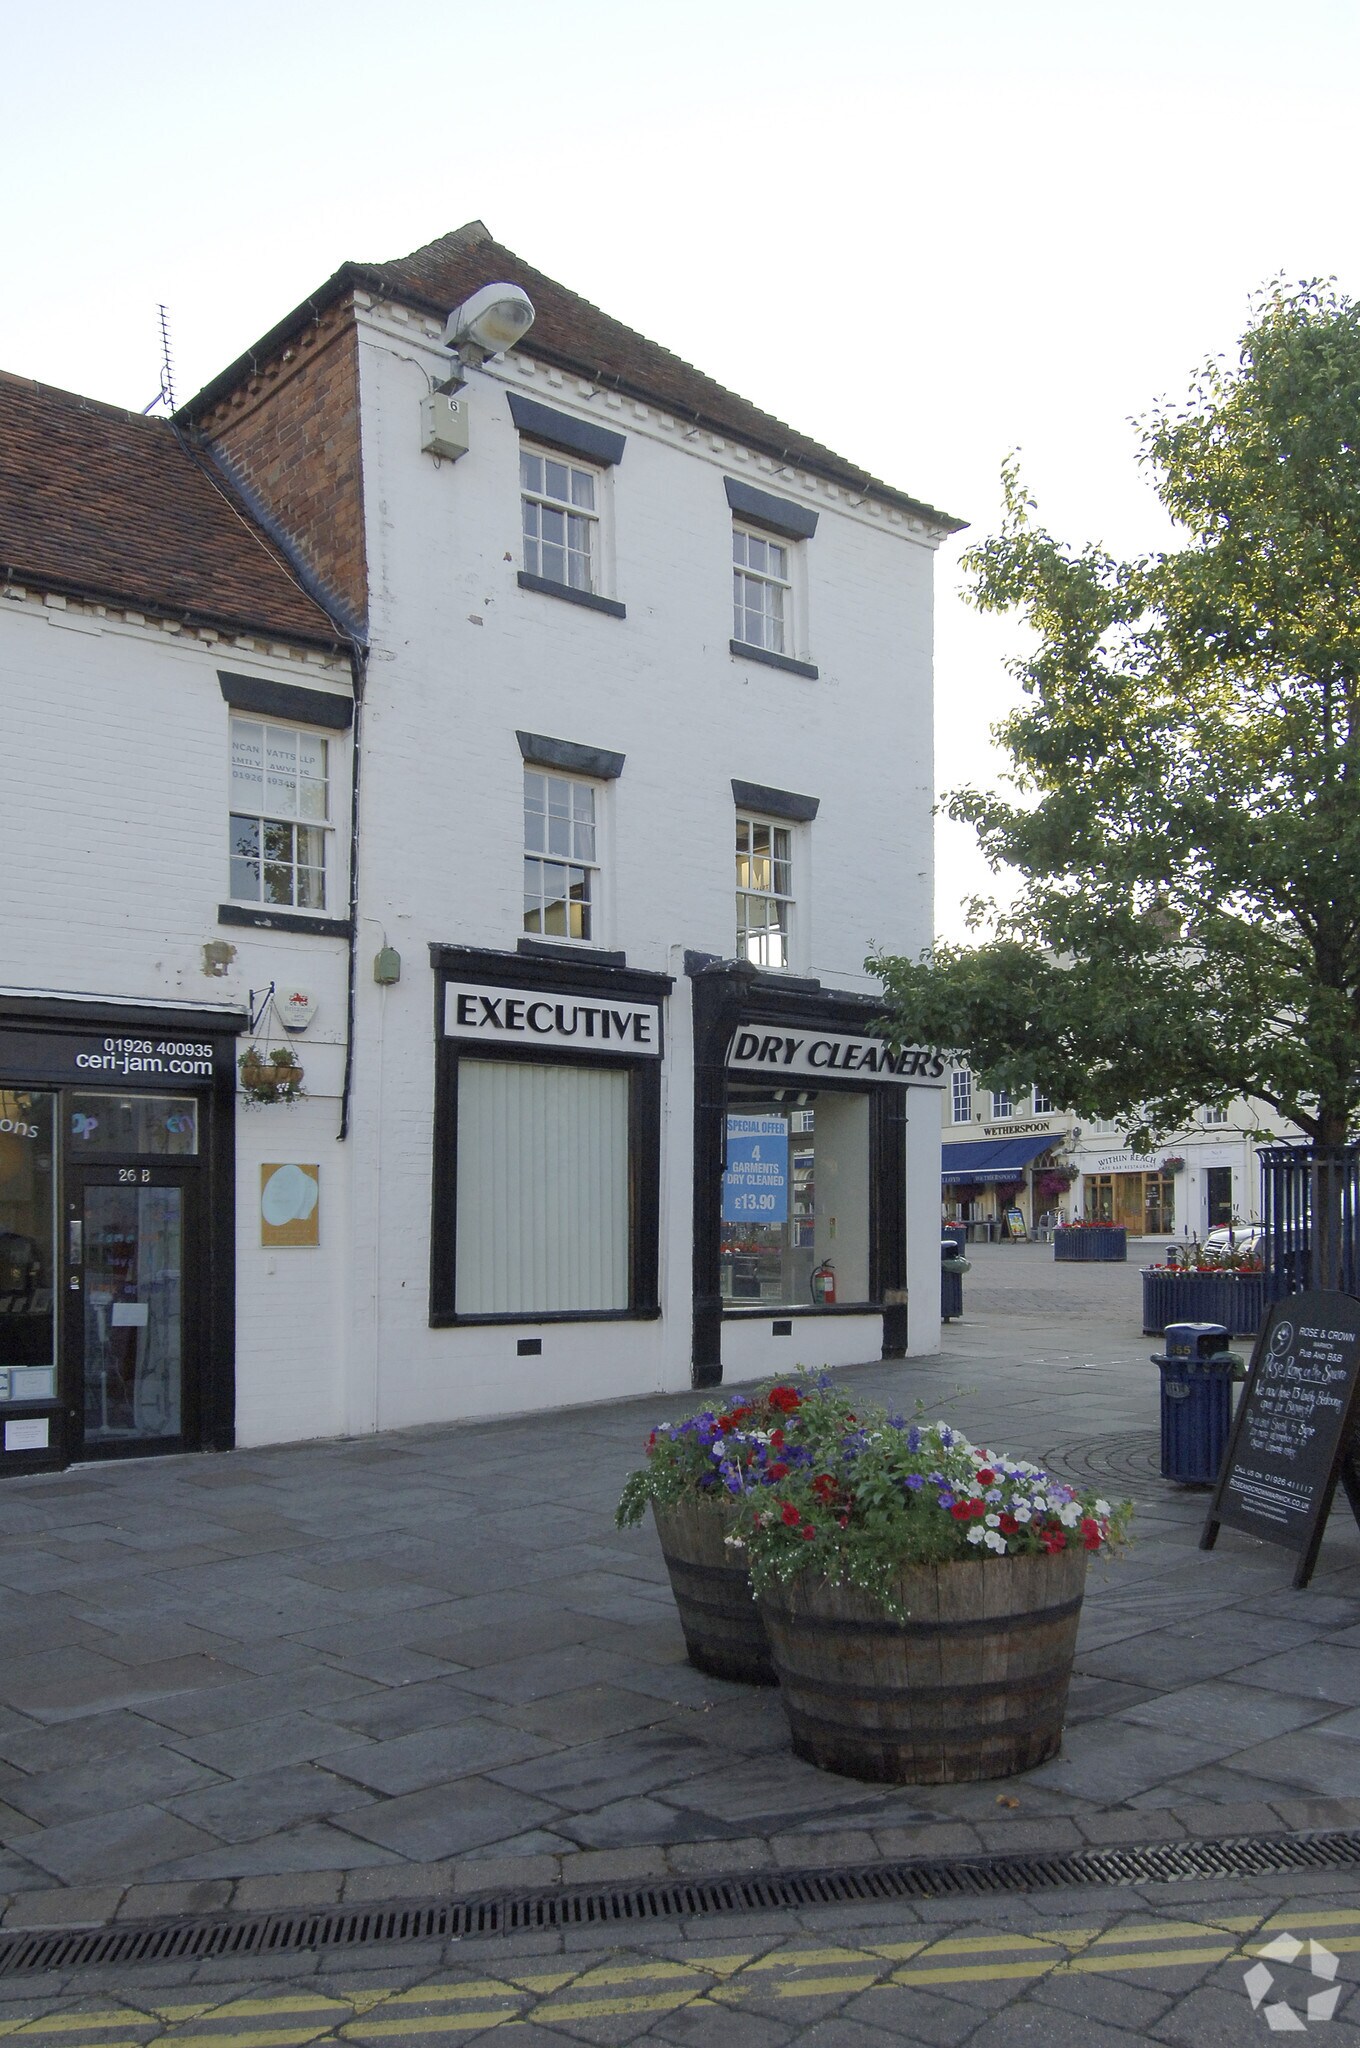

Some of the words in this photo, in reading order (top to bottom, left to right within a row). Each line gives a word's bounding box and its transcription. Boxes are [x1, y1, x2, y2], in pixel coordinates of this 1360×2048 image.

[450, 400, 458, 412] 6
[457, 993, 651, 1043] EXECUTIVE
[103, 1038, 152, 1054] 01926
[156, 1041, 213, 1058] 400935
[734, 1032, 804, 1065] DRY
[807, 1040, 945, 1079] CLEANERS
[75, 1052, 213, 1075] ceri-jam.com
[727, 1119, 760, 1133] SPECIAL
[761, 1122, 785, 1135] OFFER
[984, 1121, 1050, 1136] WETHERSPOON
[751, 1144, 761, 1162] 4
[1097, 1154, 1128, 1167] WITHIN
[1130, 1154, 1157, 1165] REACH
[732, 1161, 779, 1174] GARMENTS
[118, 1169, 137, 1182] 26
[141, 1169, 151, 1183] B
[727, 1173, 744, 1185] DRY
[747, 1174, 784, 1187] CLEANED
[1299, 1327, 1320, 1338] ROSE
[1319, 1329, 1327, 1339] &
[1327, 1330, 1356, 1342] CROWN
[1326, 1352, 1343, 1363] B&B
[1264, 1473, 1286, 1487] 01926
[1286, 1480, 1314, 1495] 411117
